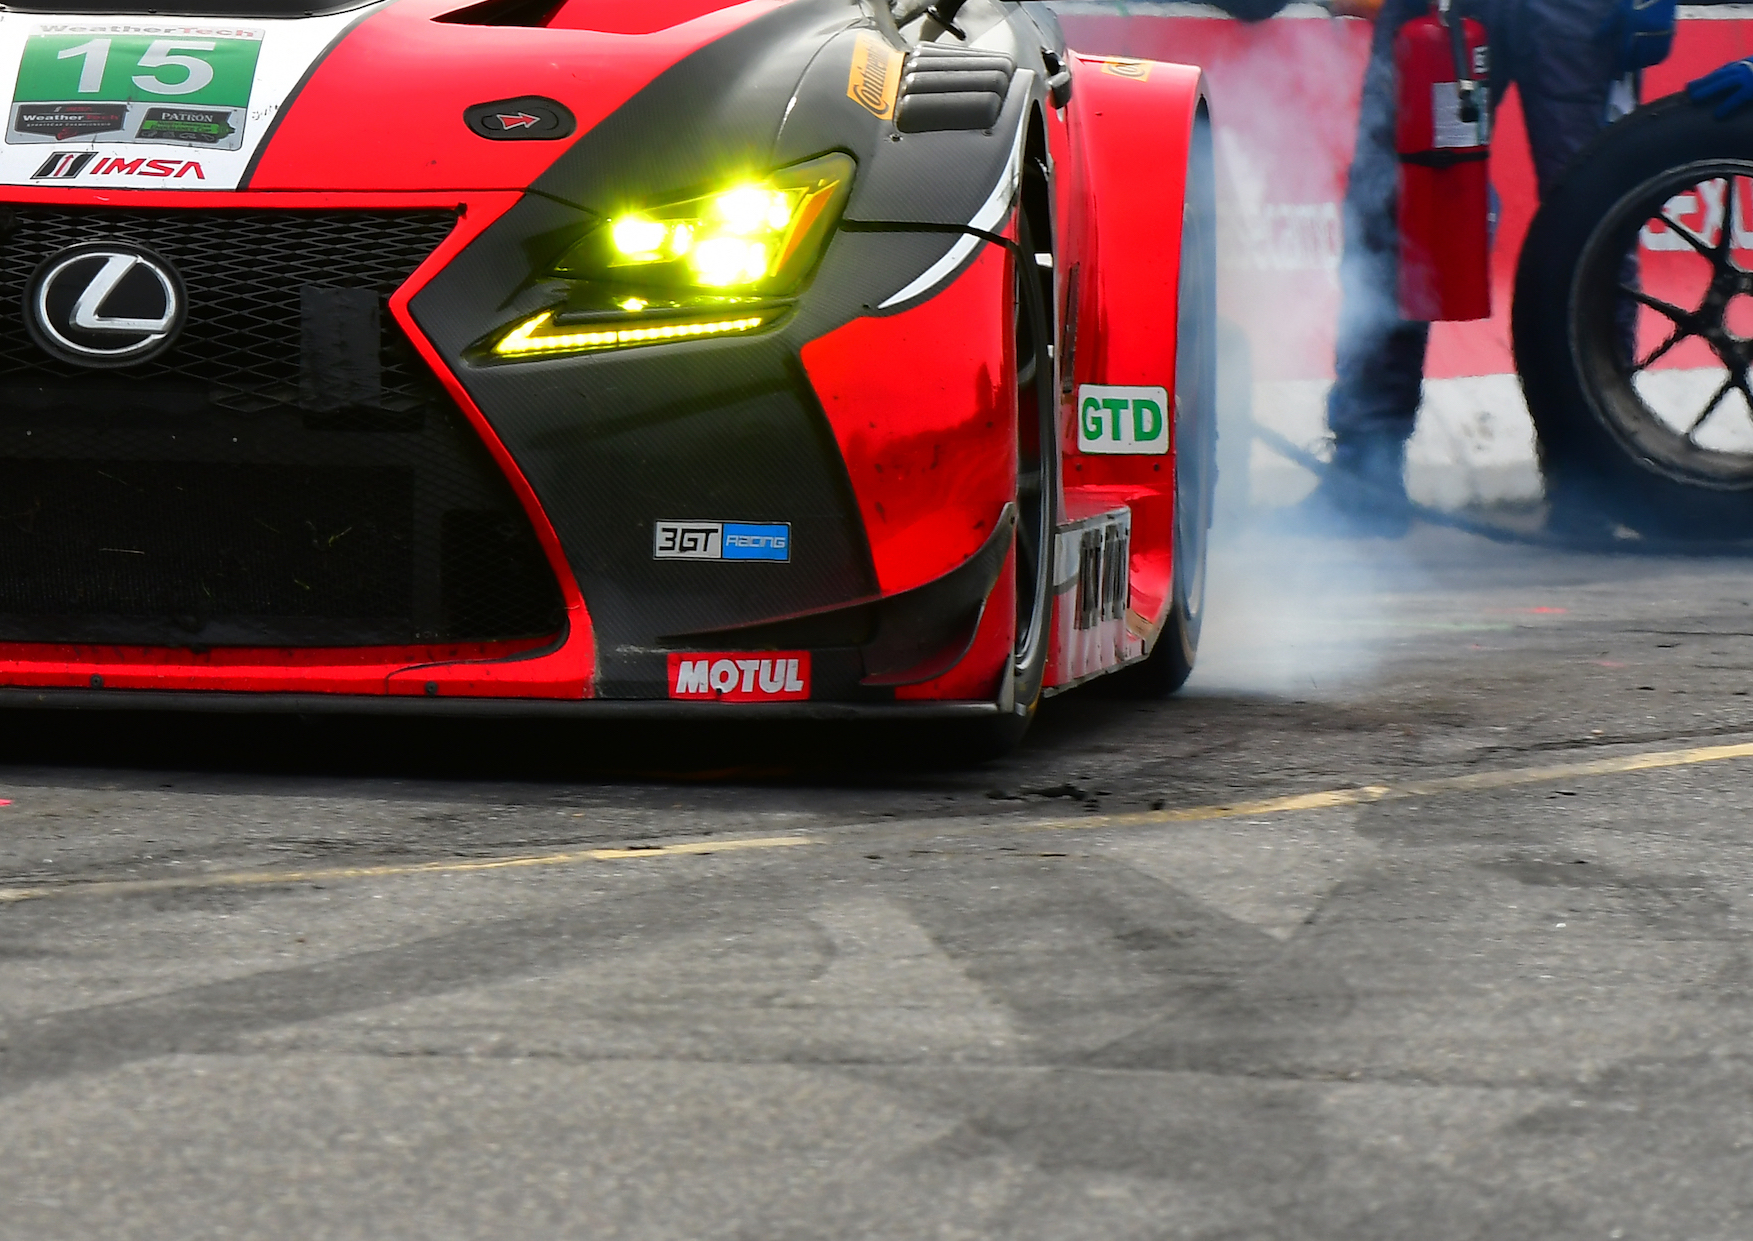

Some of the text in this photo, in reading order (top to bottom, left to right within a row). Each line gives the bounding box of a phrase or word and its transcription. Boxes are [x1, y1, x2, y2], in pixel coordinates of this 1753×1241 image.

[40, 23, 256, 39] WeatherTech
[56, 37, 217, 96] 15
[22, 113, 119, 122] WeatherTech
[89, 156, 206, 180] IMSA
[1082, 397, 1163, 442] GTD
[658, 527, 719, 552] 3GT
[676, 658, 804, 694] MOTUL
